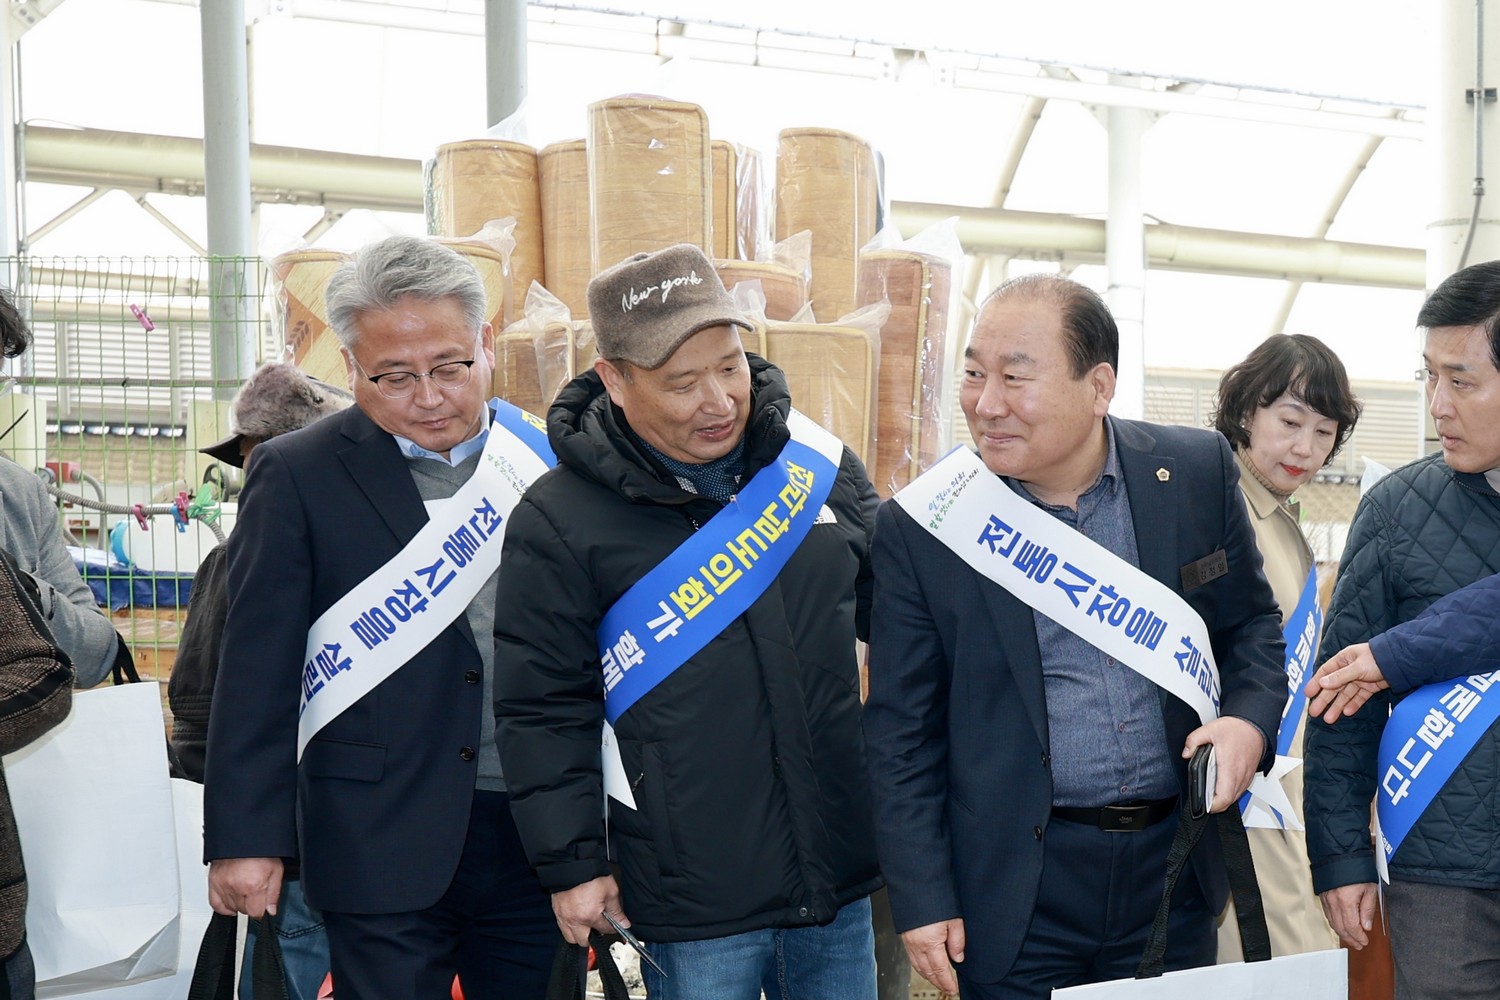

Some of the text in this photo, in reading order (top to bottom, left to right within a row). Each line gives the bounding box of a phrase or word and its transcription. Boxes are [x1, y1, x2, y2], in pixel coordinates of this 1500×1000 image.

[622, 286, 659, 313] New
[349, 496, 503, 650] 전통시장을
[977, 514, 1168, 651] 전통시장을
